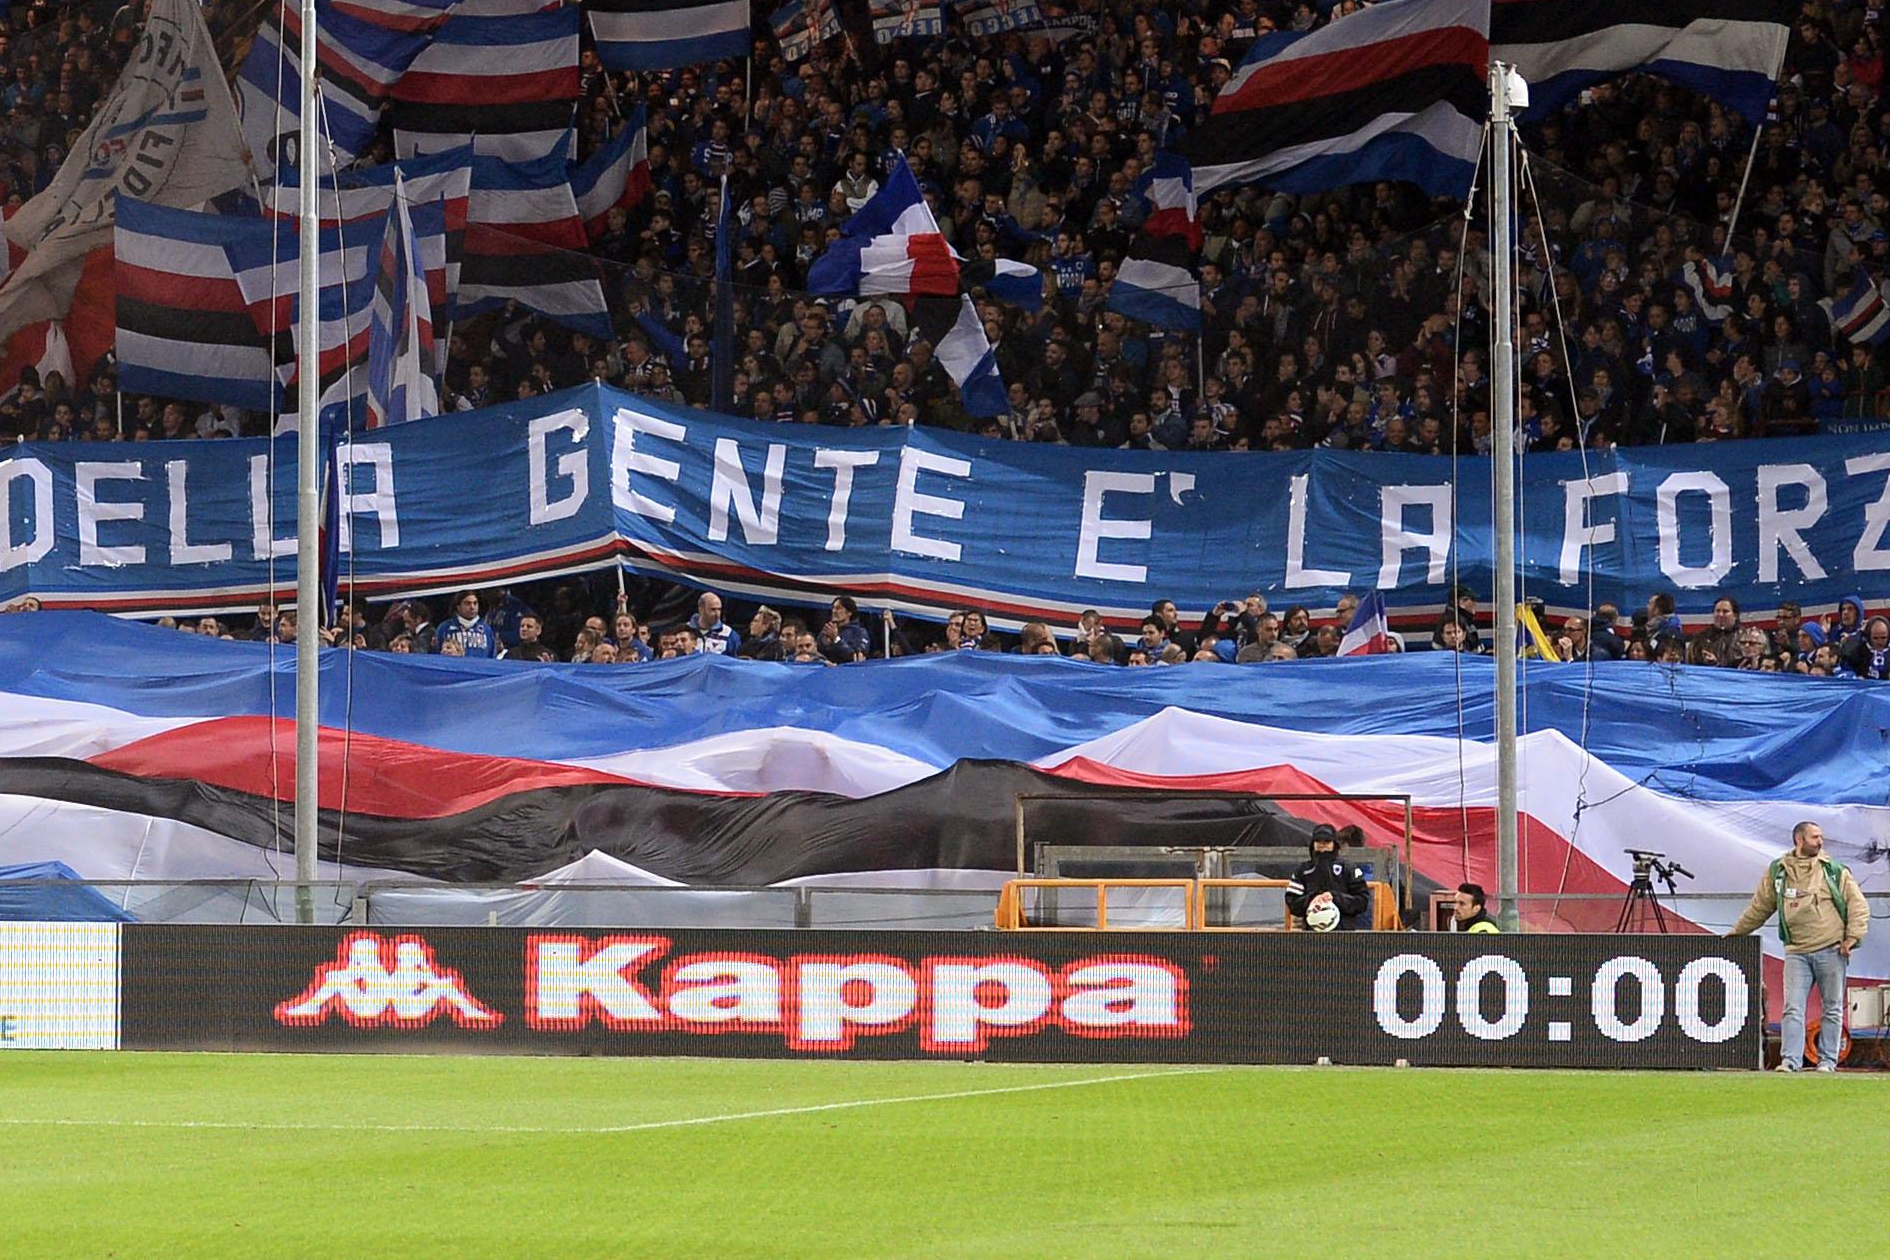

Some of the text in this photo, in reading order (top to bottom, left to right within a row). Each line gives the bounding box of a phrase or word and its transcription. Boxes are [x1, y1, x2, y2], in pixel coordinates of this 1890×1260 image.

[528, 407, 972, 562] GENTE
[1074, 471, 1196, 583] E'
[1285, 474, 1452, 589] LA
[528, 934, 1188, 1050] Kappa
[1373, 953, 1750, 1044] 00:00
